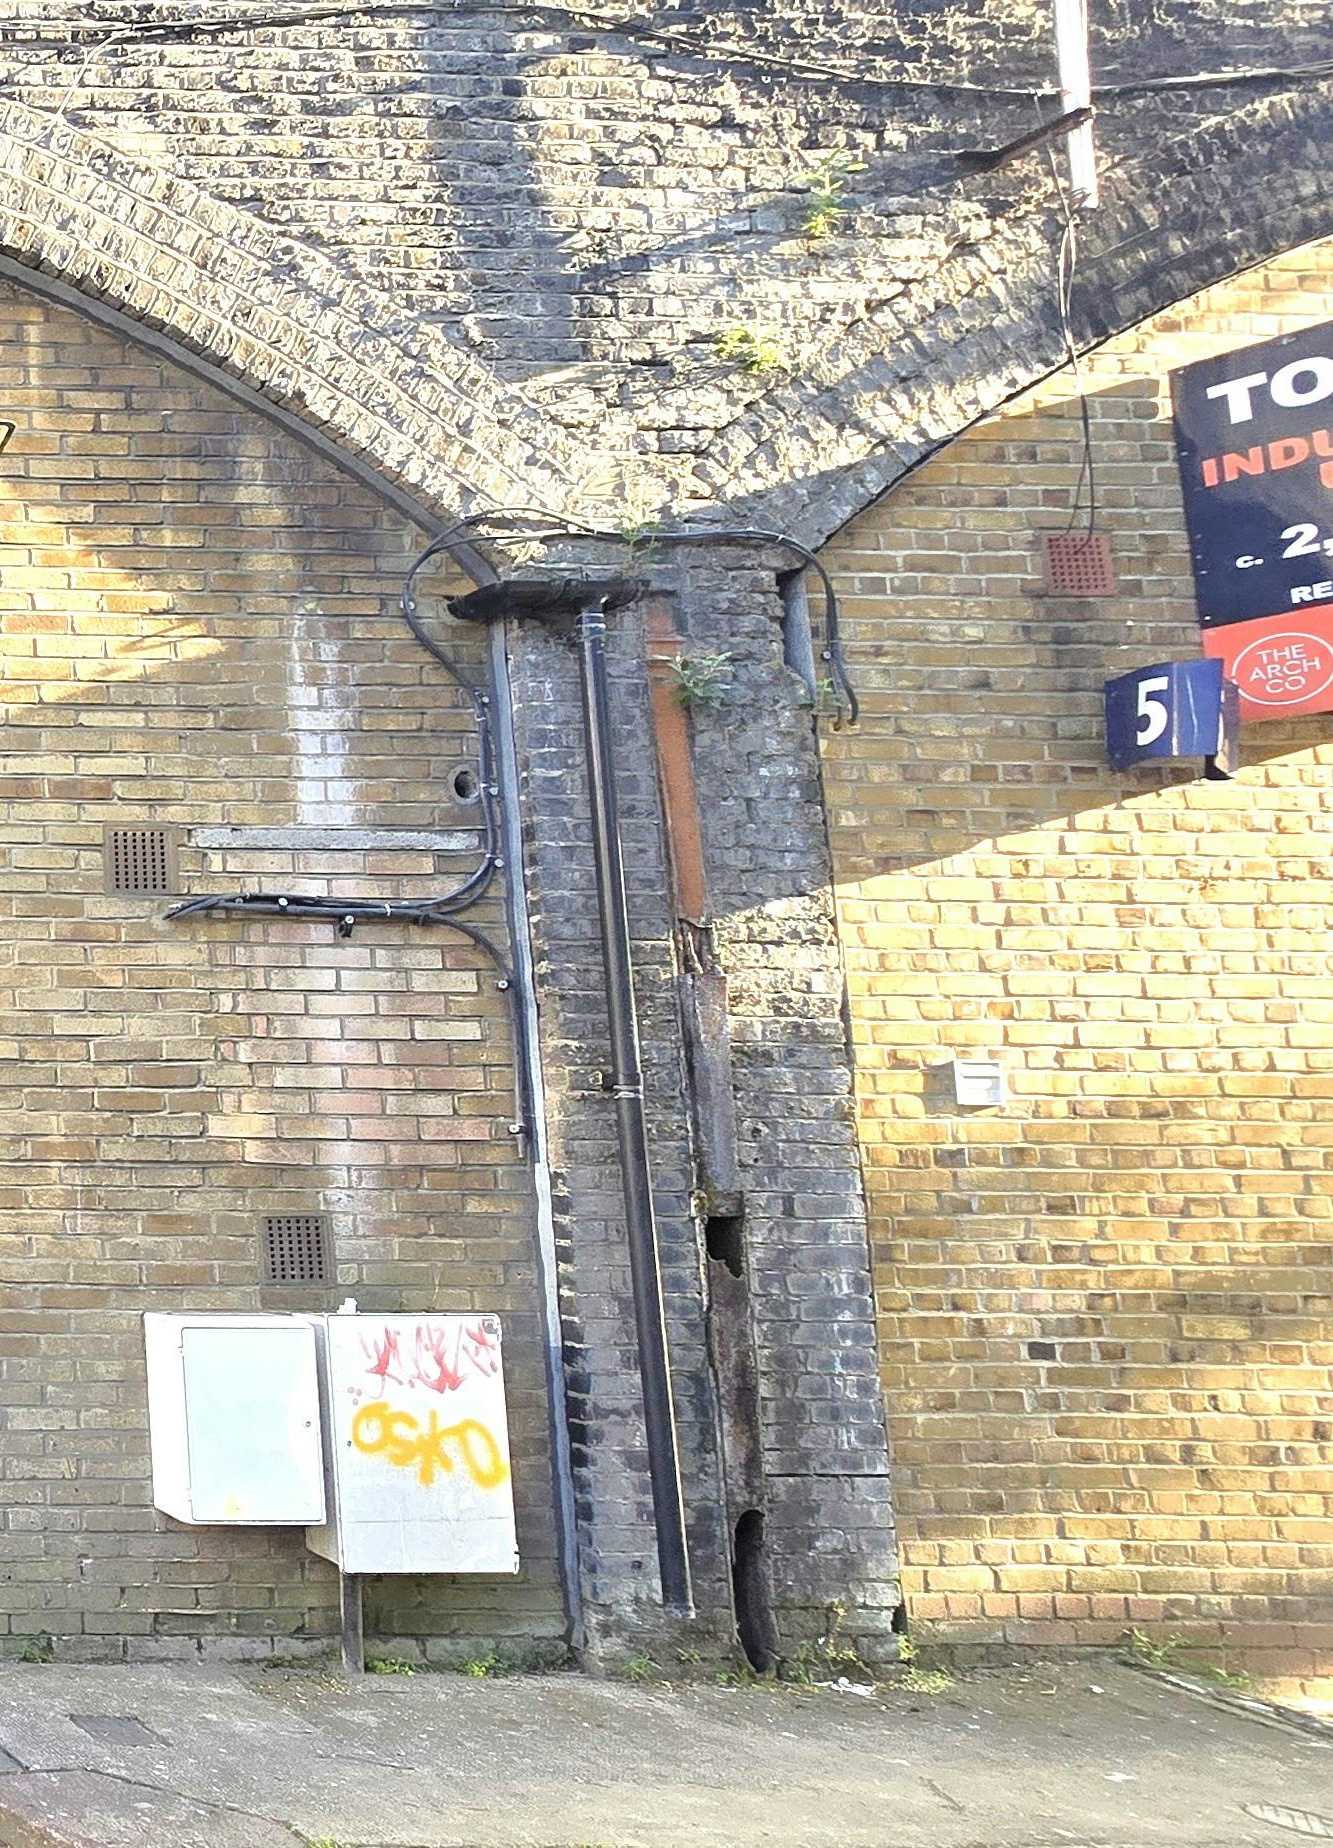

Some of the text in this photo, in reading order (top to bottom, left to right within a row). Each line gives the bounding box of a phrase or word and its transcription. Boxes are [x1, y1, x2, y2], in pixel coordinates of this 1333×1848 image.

[1206, 356, 1333, 425] TO
[1236, 555, 1264, 569] c.
[1290, 580, 1333, 604] RE
[1256, 643, 1307, 664] THE
[1249, 656, 1322, 683] ARCH
[1265, 674, 1306, 694] CO
[1136, 676, 1169, 747] 5
